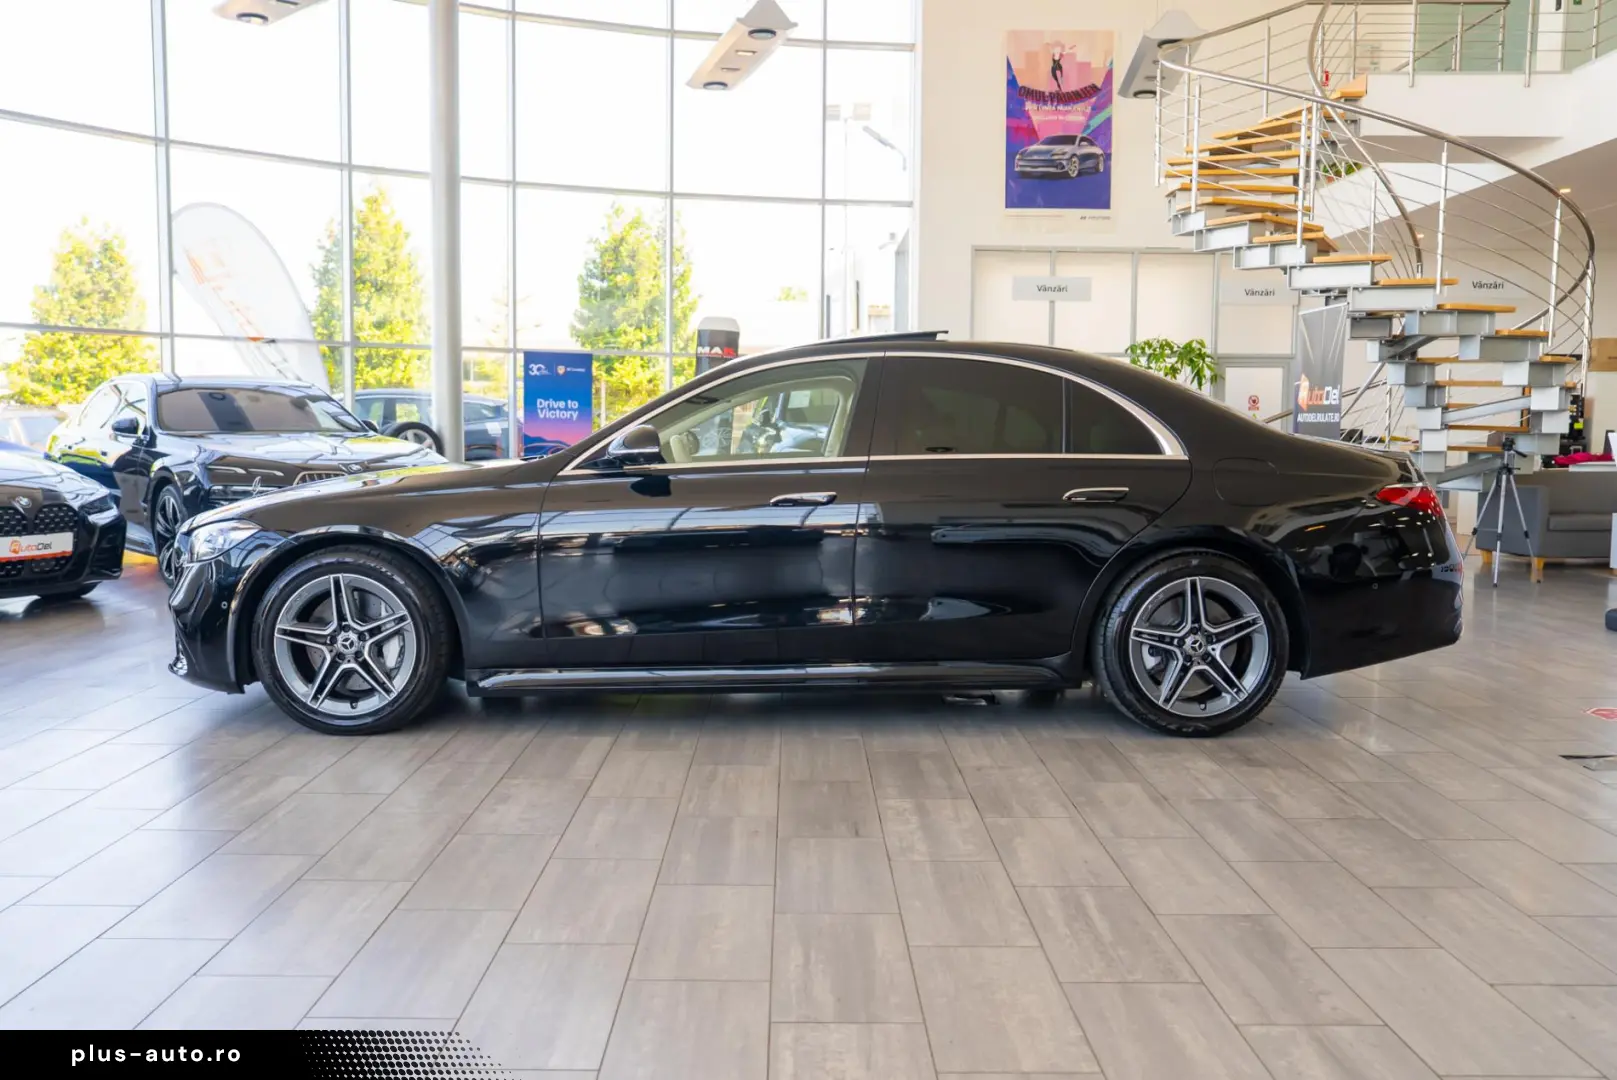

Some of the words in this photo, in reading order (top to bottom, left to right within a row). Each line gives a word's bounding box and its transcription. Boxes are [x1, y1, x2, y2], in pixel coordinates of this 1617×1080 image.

[1036, 284, 1068, 293] Vânzări
[1471, 280, 1504, 290] Vânzări
[1244, 287, 1275, 297] Vânzări
[536, 398, 566, 409] Drive
[567, 399, 579, 409] to
[537, 408, 579, 421] Victory
